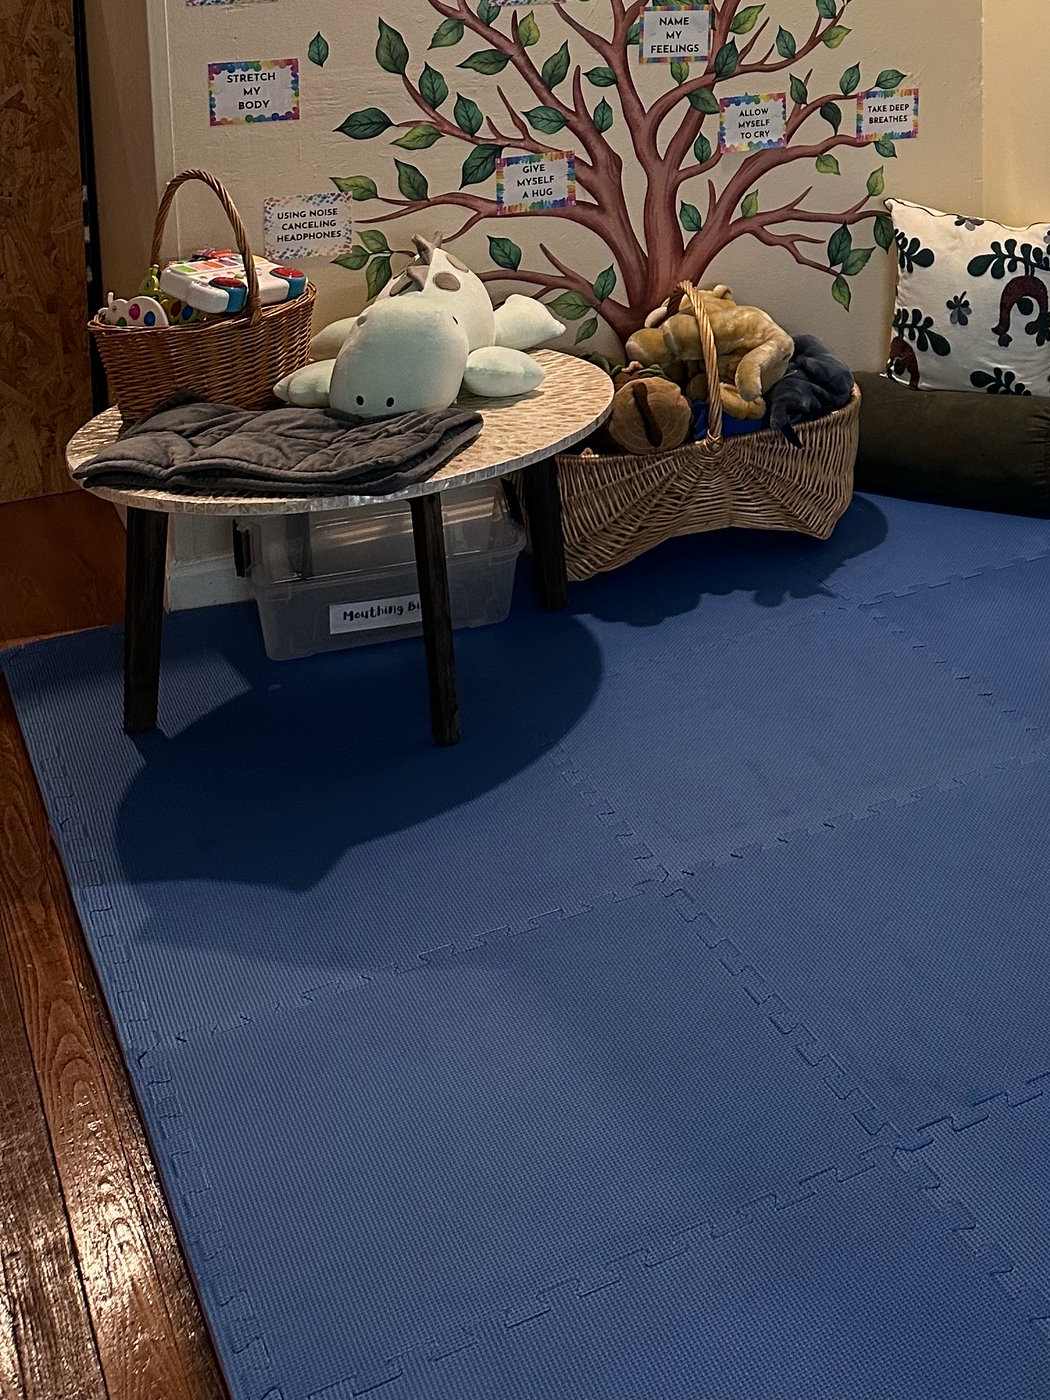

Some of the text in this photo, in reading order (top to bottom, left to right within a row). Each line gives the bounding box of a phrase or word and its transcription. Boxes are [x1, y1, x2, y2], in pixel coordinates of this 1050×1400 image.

[659, 17, 689, 26] NAME
[666, 31, 682, 40] MY
[650, 43, 699, 54] FEELINGS
[226, 72, 276, 83] STRETCH
[243, 86, 261, 96] MY
[238, 100, 270, 110] BODY
[867, 103, 911, 114] TAKE DEEP
[739, 108, 769, 118] ALLOW
[738, 118, 770, 129] MYSELF
[868, 114, 908, 125] BREATHES
[741, 129, 770, 139] TO CRY
[522, 164, 546, 174] GIVE
[516, 175, 555, 187] MYSELF
[522, 187, 553, 198] A HUG
[277, 208, 338, 220] USING NOISE
[281, 220, 337, 230] CANCELING
[276, 230, 342, 242] HEADPHONES
[343, 605, 404, 621] Mouthing
